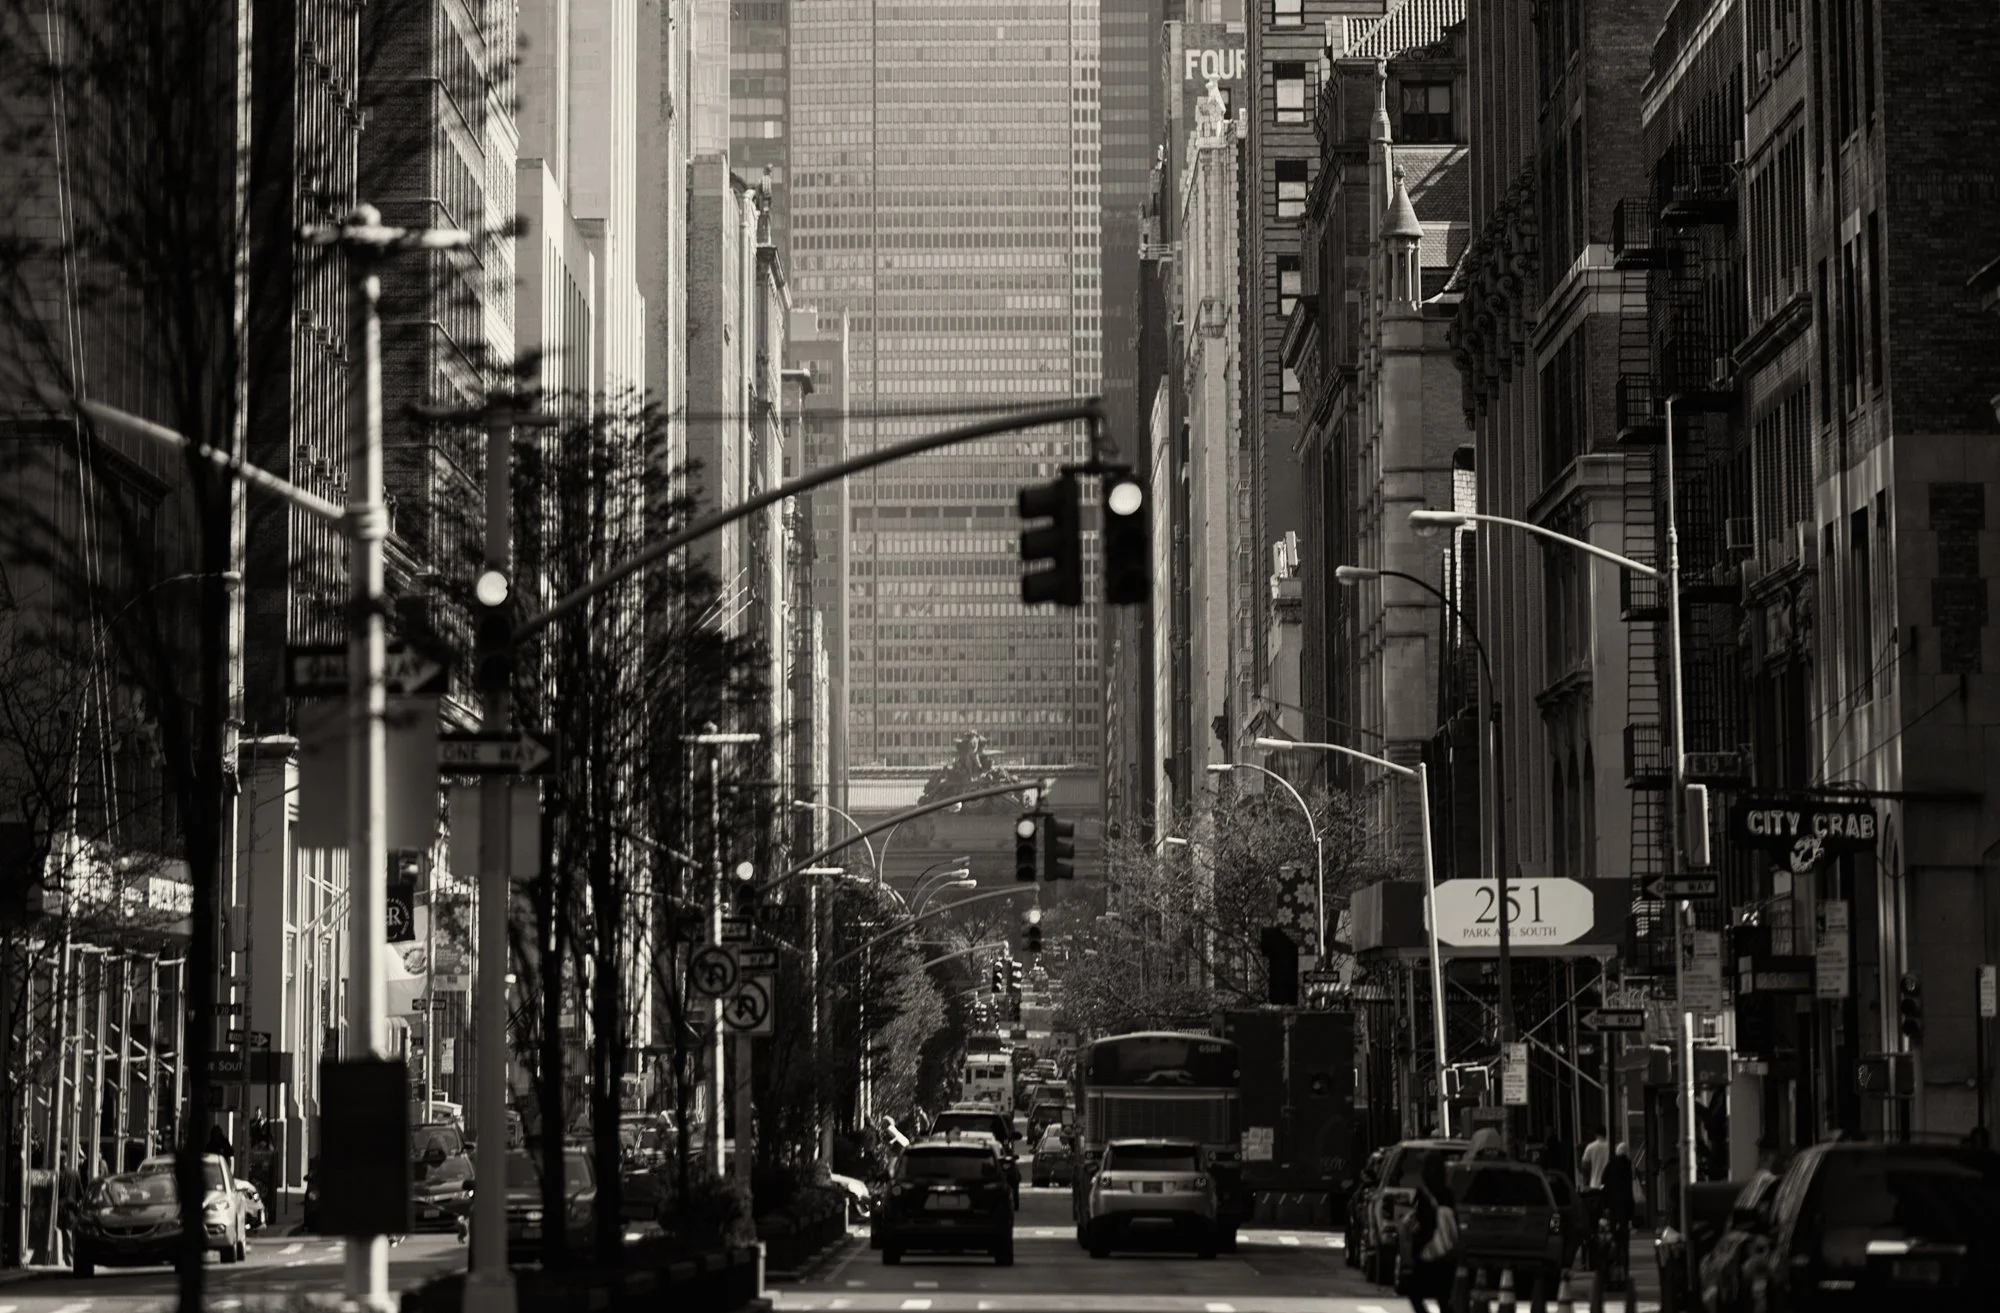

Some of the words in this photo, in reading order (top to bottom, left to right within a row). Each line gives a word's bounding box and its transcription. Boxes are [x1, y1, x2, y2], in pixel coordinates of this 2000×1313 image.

[1185, 48, 1246, 80] FOUR
[442, 745, 481, 762] ONE
[499, 745, 537, 761] WAY
[1746, 808, 1801, 836] CITY
[1811, 812, 1876, 840] CRAB
[1688, 880, 1711, 894] WAY
[1475, 884, 1545, 924] 251
[1463, 927, 1493, 939] PARK
[1519, 925, 1557, 938] SOUTH
[1589, 1016, 1608, 1026] ONE
[1617, 1015, 1639, 1025] WAY
